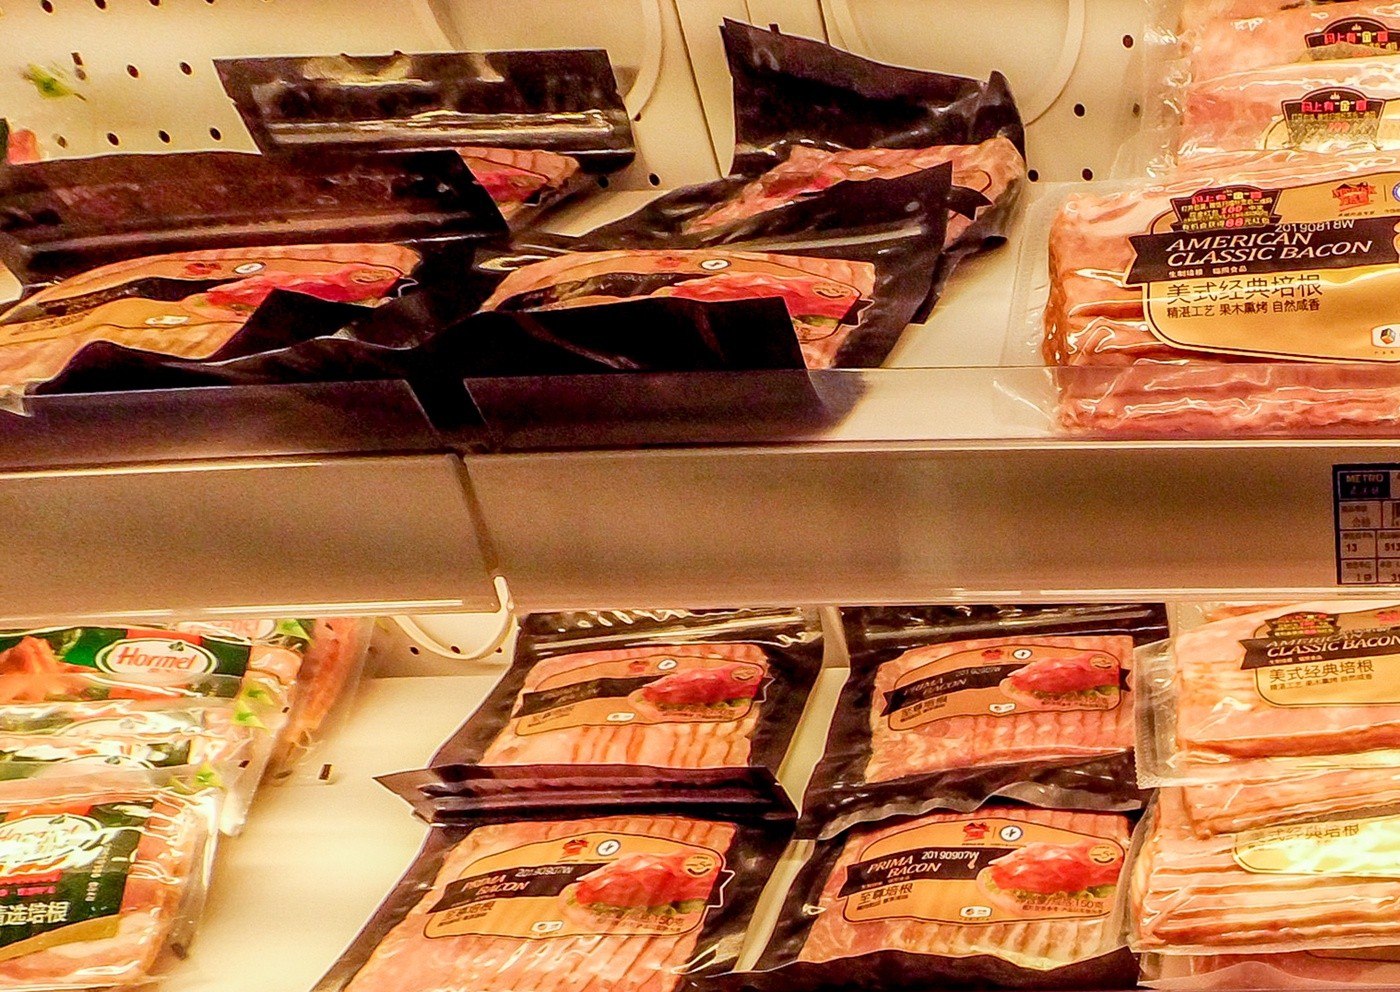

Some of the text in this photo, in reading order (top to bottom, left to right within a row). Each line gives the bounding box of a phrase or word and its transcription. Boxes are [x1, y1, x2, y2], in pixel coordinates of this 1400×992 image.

[1166, 232, 1312, 252] AMERICAN
[1167, 241, 1372, 267] CLASSIC BACON
[1167, 274, 1323, 304] 美式经典培根
[1167, 305, 1214, 318] 精湛工艺
[1273, 298, 1320, 313] 自然咸香
[1346, 474, 1384, 484] METRO
[116, 647, 197, 669] Hormel
[1267, 641, 1339, 658] CLASSIC
[1269, 659, 1375, 682] 美式经典培根
[867, 855, 914, 874] PRIMA
[887, 862, 942, 878] BACON
[0, 901, 71, 926] 选培根
